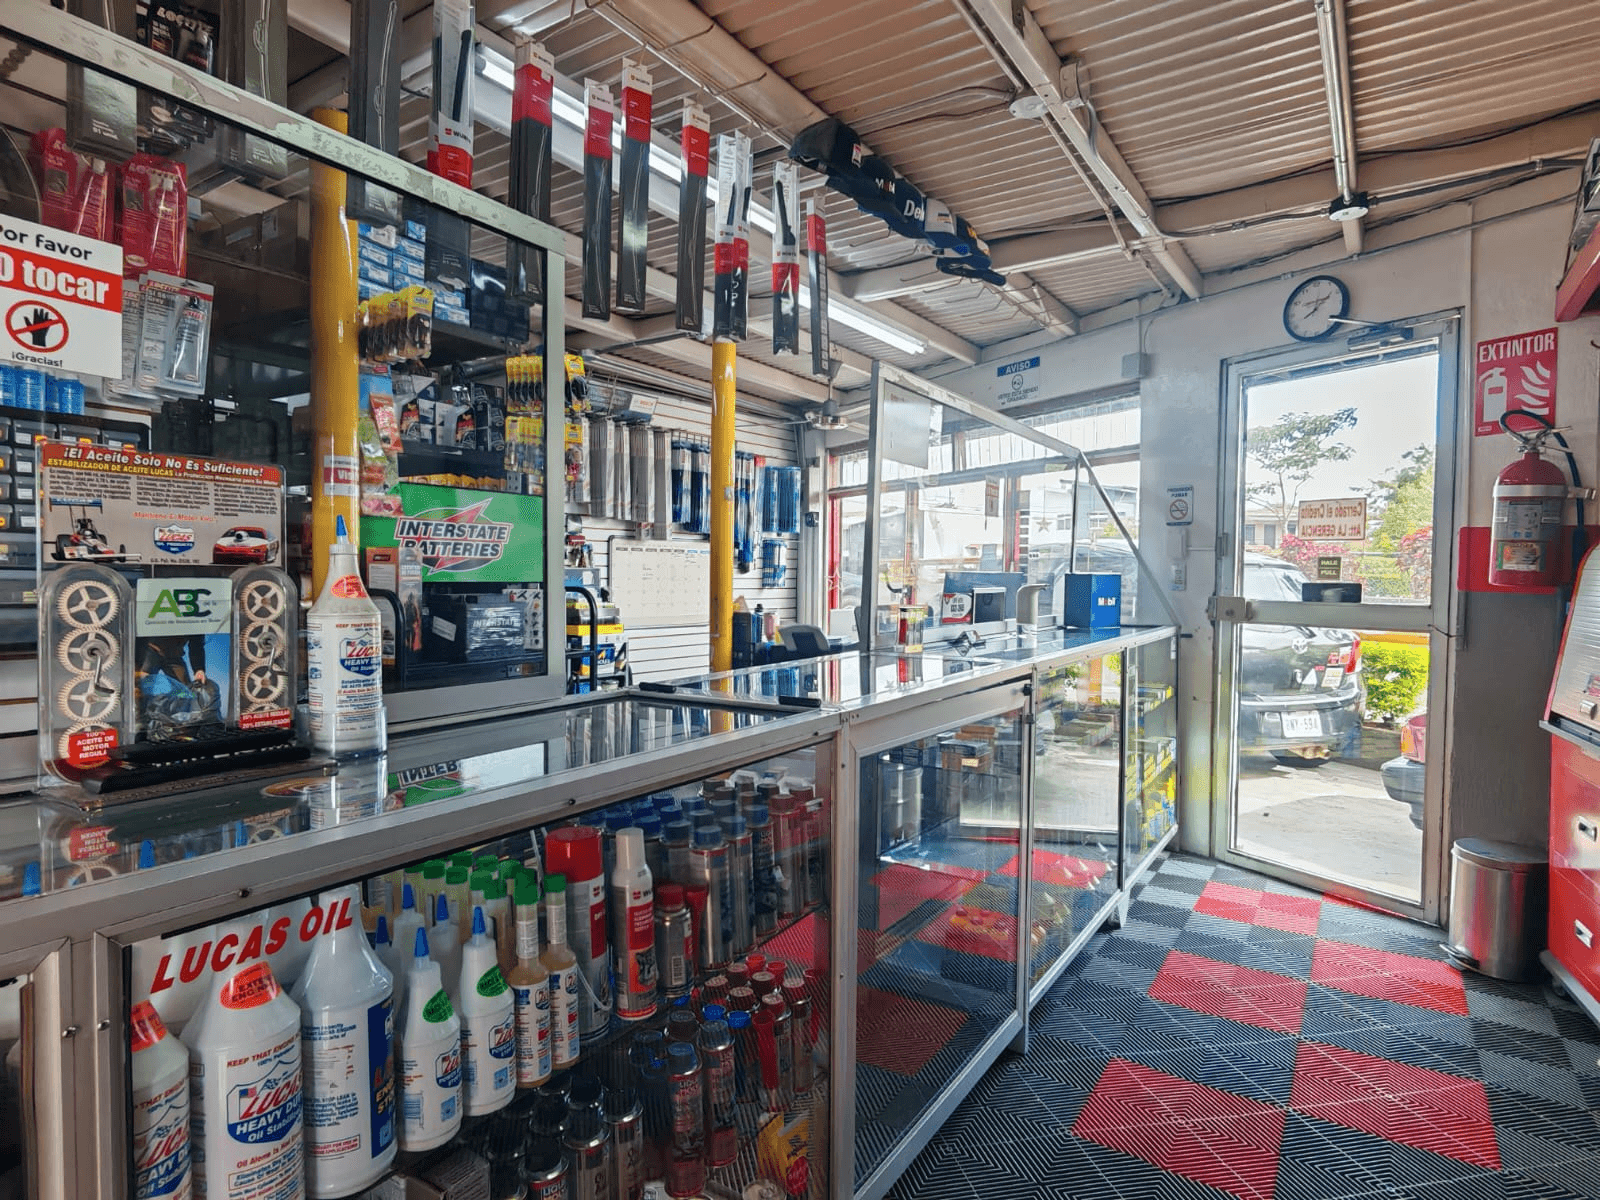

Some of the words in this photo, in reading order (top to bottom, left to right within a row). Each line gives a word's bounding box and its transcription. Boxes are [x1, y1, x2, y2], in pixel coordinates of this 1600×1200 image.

[904, 200, 925, 221] Del
[0, 226, 28, 244] or
[36, 234, 93, 261] favor
[22, 260, 110, 305] tocar
[1480, 333, 1554, 363] EXTINTOR
[12, 352, 64, 368] ¡Gracias!
[1006, 361, 1031, 375] AVISO
[48, 458, 110, 473] ESTABILIZADOR
[111, 464, 121, 472] DE
[123, 465, 149, 475] ACEITE
[150, 468, 174, 477] LUCAS
[87, 450, 130, 465] Aceite
[134, 454, 162, 468] Solo
[166, 458, 182, 469] No
[186, 460, 200, 471] Es
[203, 462, 264, 477] Suficiente!
[399, 521, 508, 540] INTERSTATE
[404, 540, 500, 557] BATTERIES
[148, 588, 212, 618] ABC
[77, 737, 103, 746] ACEITE
[82, 743, 109, 752] MOTOR
[80, 749, 108, 759] REGULA
[150, 916, 292, 995] LUCAS
[299, 897, 354, 943] OIL
[227, 1056, 250, 1068] KEEP
[252, 1049, 273, 1061] THAT
[236, 1109, 285, 1136] HEAVY
[247, 1130, 264, 1142] Oil
[138, 1157, 176, 1186] EAVY
